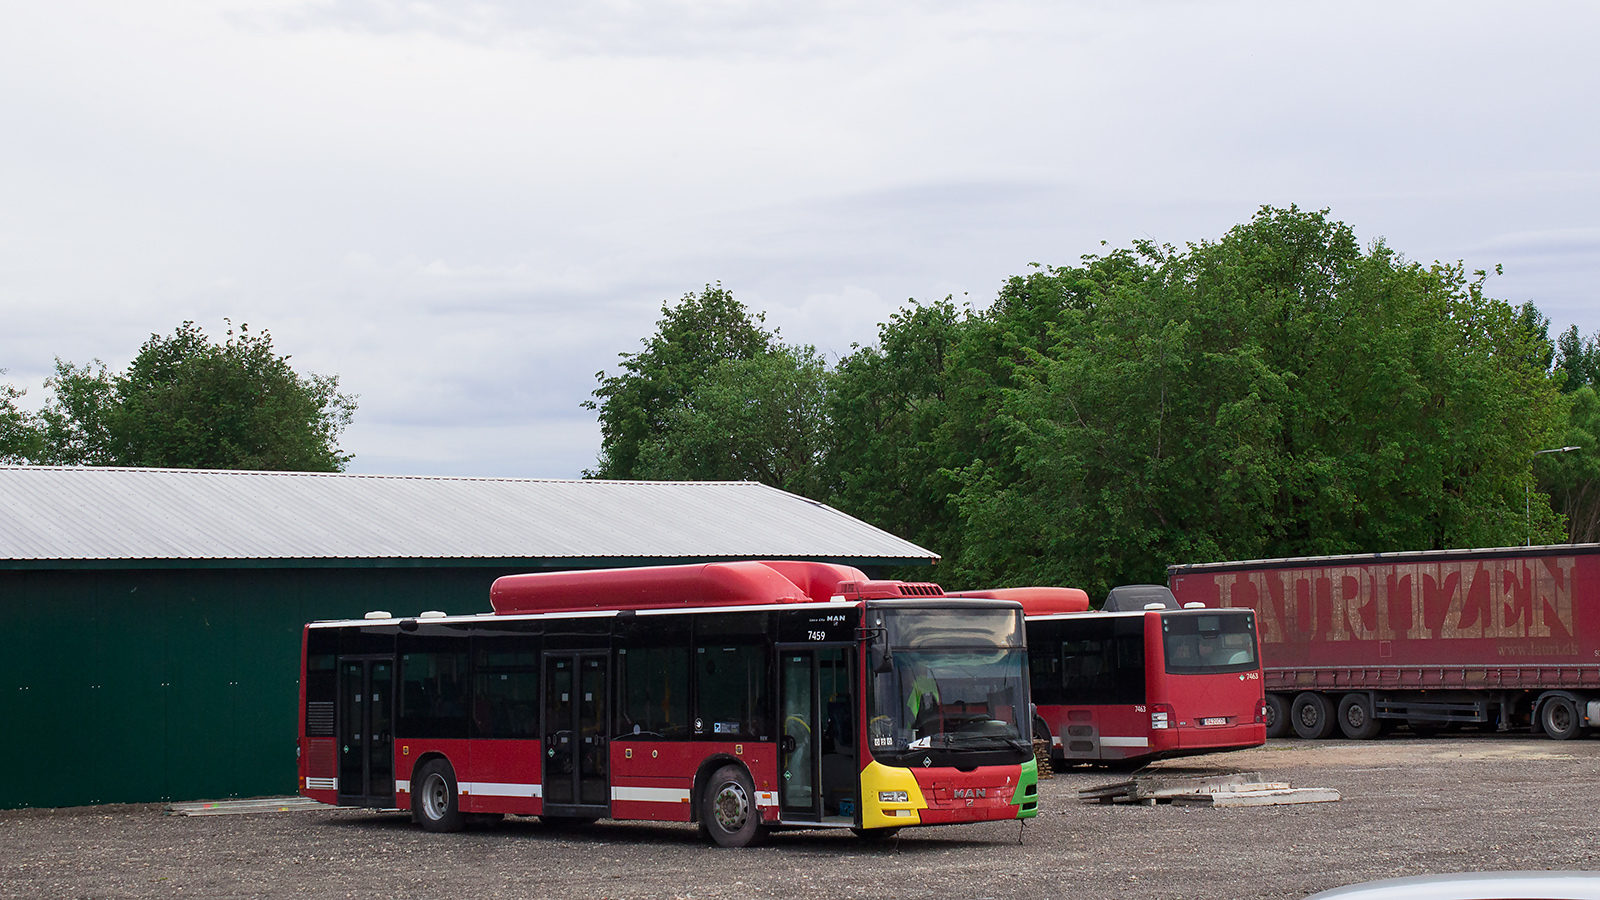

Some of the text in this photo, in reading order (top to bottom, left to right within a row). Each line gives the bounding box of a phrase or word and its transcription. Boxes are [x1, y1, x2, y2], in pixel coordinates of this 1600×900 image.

[807, 630, 825, 640] 7459
[1497, 642, 1579, 656] www.lauri.dk
[1246, 672, 1259, 680] 7463
[953, 788, 986, 798] MAN
